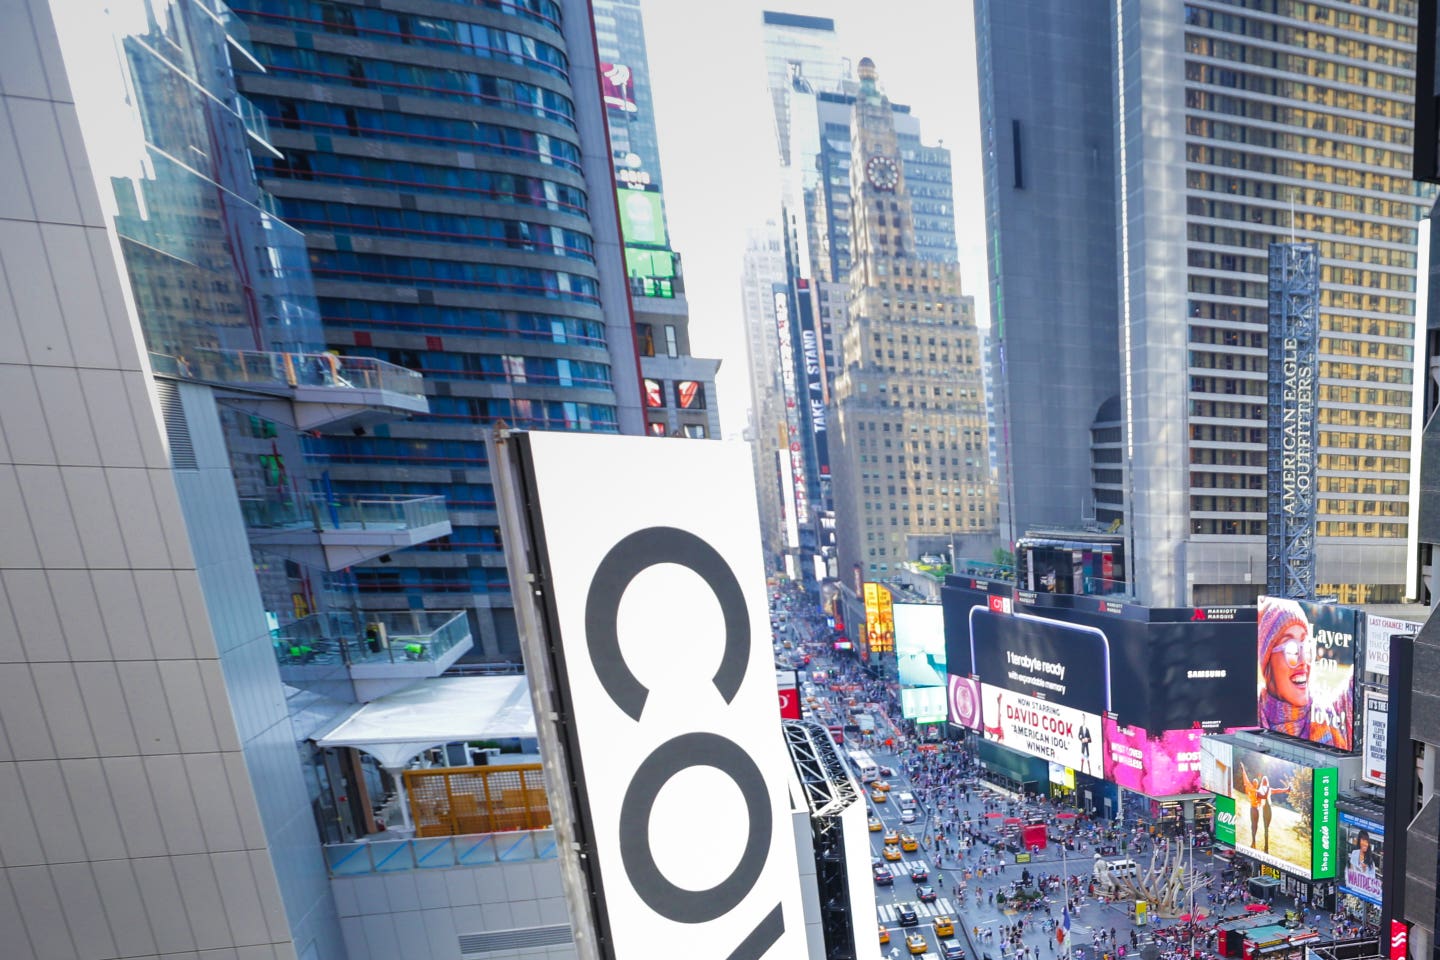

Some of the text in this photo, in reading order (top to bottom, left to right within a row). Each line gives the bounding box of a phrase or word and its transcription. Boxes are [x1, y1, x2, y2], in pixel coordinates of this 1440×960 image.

[802, 330, 827, 433] TAKE A STAND
[1283, 337, 1298, 516] AMERICAN EAGLE
[1297, 366, 1312, 493] OUTFITTERS
[1369, 617, 1382, 627] LAST
[1382, 619, 1404, 631] CHANCE!
[1308, 624, 1353, 649] Layer
[1008, 671, 1019, 680] with
[1011, 652, 1042, 673] terabyte
[1041, 660, 1066, 680] ready
[1187, 670, 1227, 678] SAMSUNG
[1017, 697, 1061, 717] NOW STARRING
[1311, 703, 1346, 730] love!
[1006, 704, 1074, 739] DAVID COOK
[1026, 740, 1056, 758] WINNER
[1178, 763, 1189, 772] IN
[1323, 786, 1330, 796] on
[1321, 852, 1330, 872] Shop
[1346, 870, 1383, 896] WAITRESS
